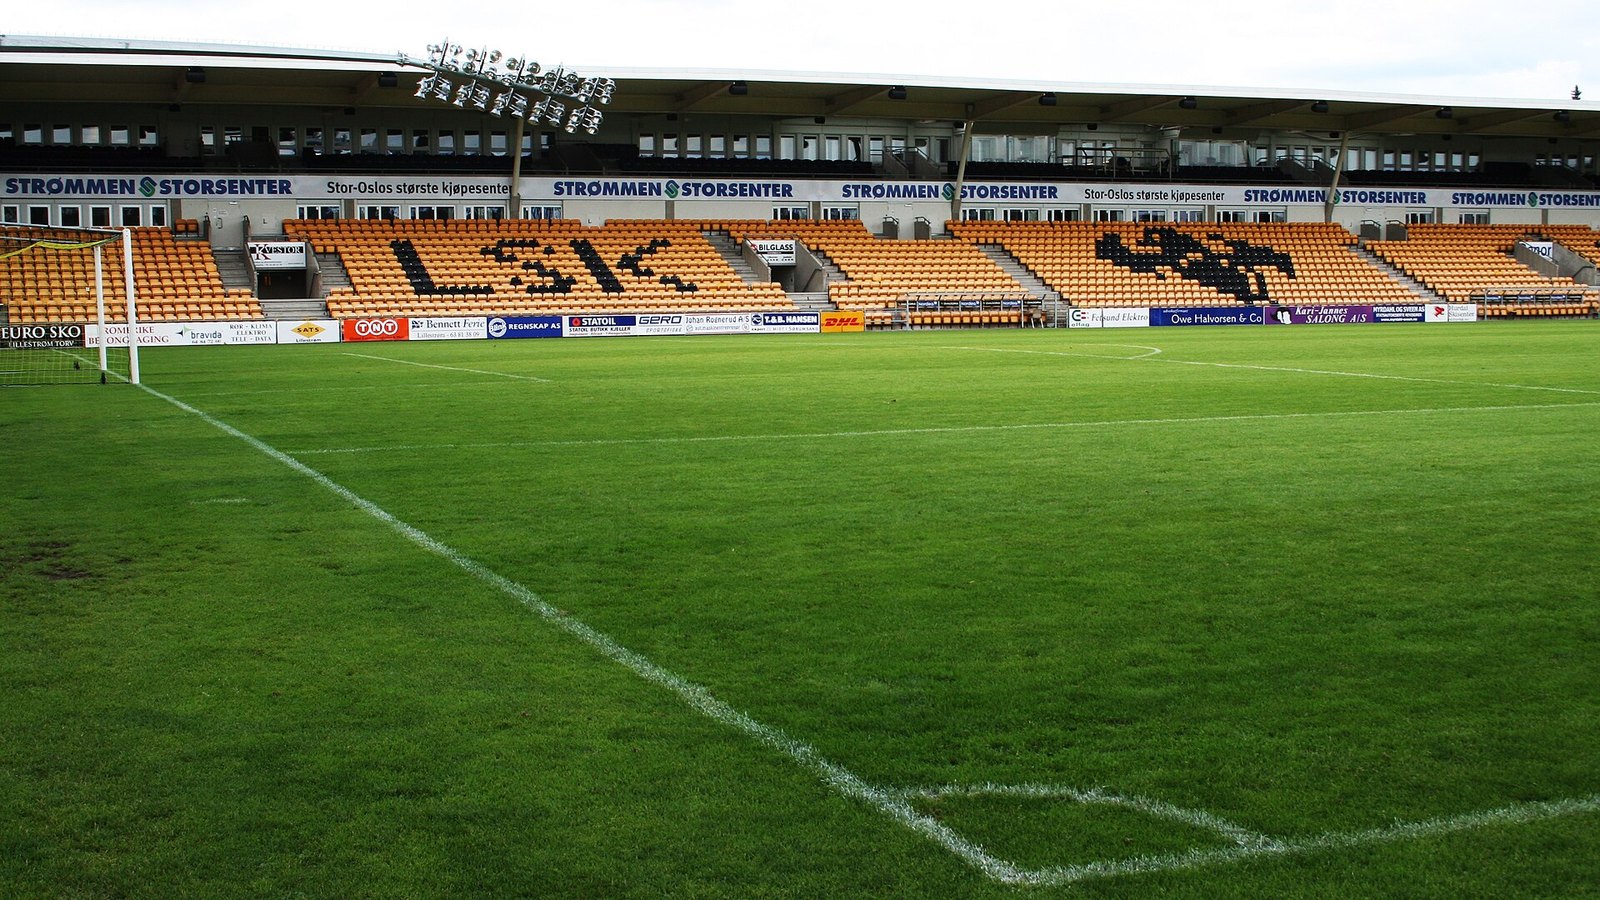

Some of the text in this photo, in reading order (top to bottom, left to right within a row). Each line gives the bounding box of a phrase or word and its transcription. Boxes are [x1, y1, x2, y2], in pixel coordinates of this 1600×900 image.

[6, 177, 293, 196] STRØMMEN STORSENTER
[327, 181, 393, 194] Stor-Oslos
[396, 182, 439, 195] største
[553, 180, 793, 198] STRØMMEN STORSENTER
[842, 183, 1057, 199] STRØMMEN STORSENTER
[1085, 188, 1224, 203] Stor-Oslos største kjøpesenter
[1244, 189, 1426, 205] STRØMMEN STORSENTER
[1452, 192, 1525, 206] STRØMMEN
[1295, 306, 1348, 315] Kari-Jannes
[581, 317, 617, 326] STATOIL
[786, 315, 818, 323] HANSEN
[825, 317, 860, 326] DHL
[1122, 313, 1148, 321] Elektro
[1171, 313, 1262, 323] Owe Halvorsen & Co
[1305, 313, 1367, 324] SALONG A/S
[357, 322, 396, 333] TNT
[426, 320, 460, 329] Bennett
[463, 319, 485, 328] Ferie
[1, 325, 81, 339] EURO SKO
[105, 326, 155, 334] ROMEIKE
[190, 330, 222, 339] bravida
[88, 335, 169, 345] BEONGAGING
